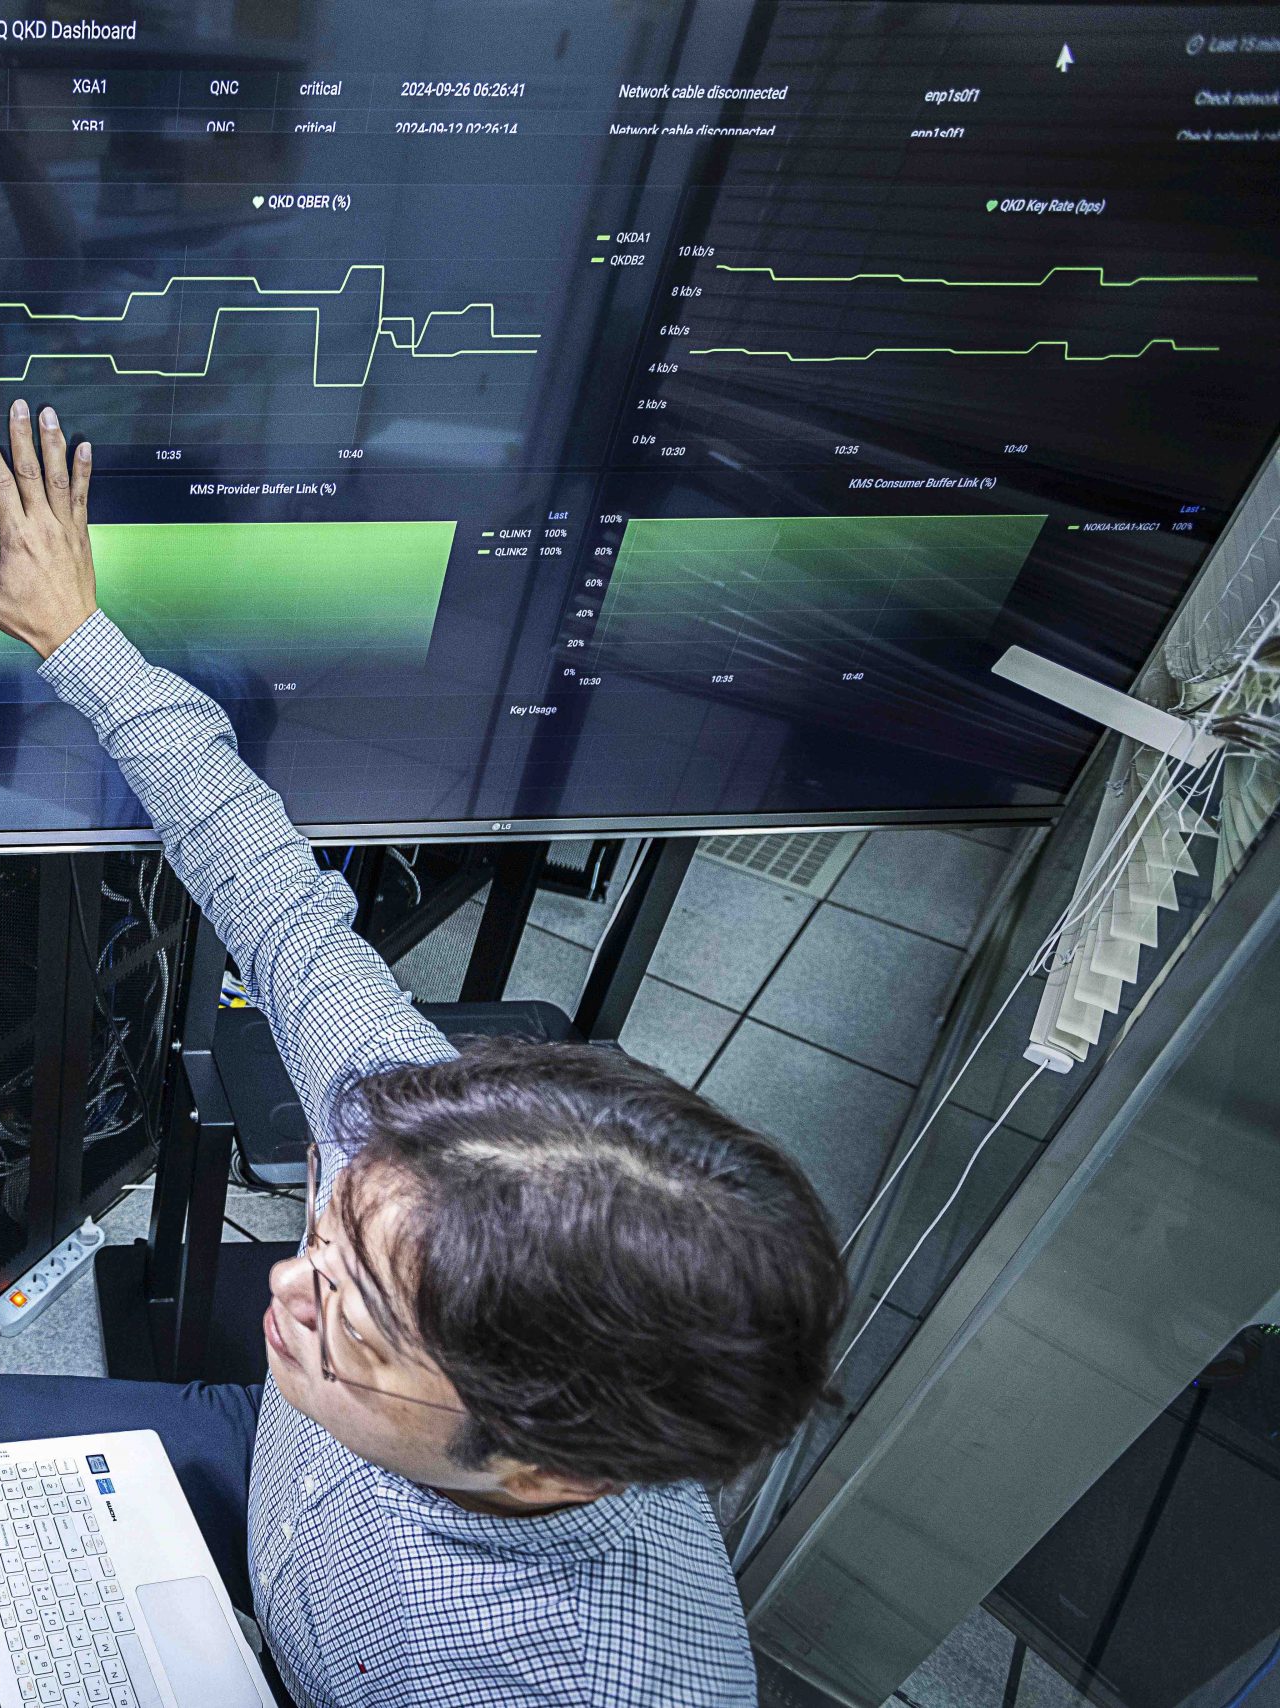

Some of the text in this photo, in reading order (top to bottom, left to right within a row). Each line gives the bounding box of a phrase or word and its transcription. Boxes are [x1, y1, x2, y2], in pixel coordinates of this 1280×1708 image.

[12, 20, 46, 41] QKD
[52, 20, 136, 40] Dashboard
[72, 79, 106, 94] XGA1
[210, 80, 239, 96] QNC
[300, 80, 342, 96] critical
[401, 82, 526, 97] 2024-09-26 06:26:41
[618, 84, 788, 100] Network cable disconnected
[268, 195, 351, 210] QKD QBER (%)
[1000, 200, 1106, 214] QKD Key Rate (bps)
[616, 232, 650, 244] QKDA1
[678, 246, 714, 256] 10 kb/s
[610, 255, 644, 267] QKDB2
[672, 286, 702, 297] 8 kb/s
[660, 326, 690, 336] 6 kb/s
[648, 363, 678, 373] 4 kb/s
[637, 400, 667, 409] 2 kb/s
[640, 436, 656, 444] b/s
[661, 447, 685, 456] 10:30
[834, 446, 860, 454] 10:35
[1004, 444, 1028, 453] 10:40
[155, 449, 182, 460] 10:35
[338, 449, 364, 459] 10:40
[848, 477, 997, 489] KMS Consumer Buffer Link (%)
[190, 483, 337, 496] KMS Provider Buffer Link (%)
[548, 511, 568, 520] Last
[600, 514, 623, 523] 100%
[499, 529, 567, 538] QLINK1 100%
[495, 547, 562, 556] QLINK2 100%
[594, 547, 612, 556] 80%
[585, 579, 603, 587] 60%
[576, 610, 594, 618] 40%
[567, 639, 584, 648] 20%
[564, 668, 576, 676] 0%
[841, 672, 864, 681] 10:40
[579, 678, 601, 686] 10:30
[711, 674, 734, 683] 10:35
[273, 682, 296, 691] 10:40
[510, 706, 557, 715] Key Usage
